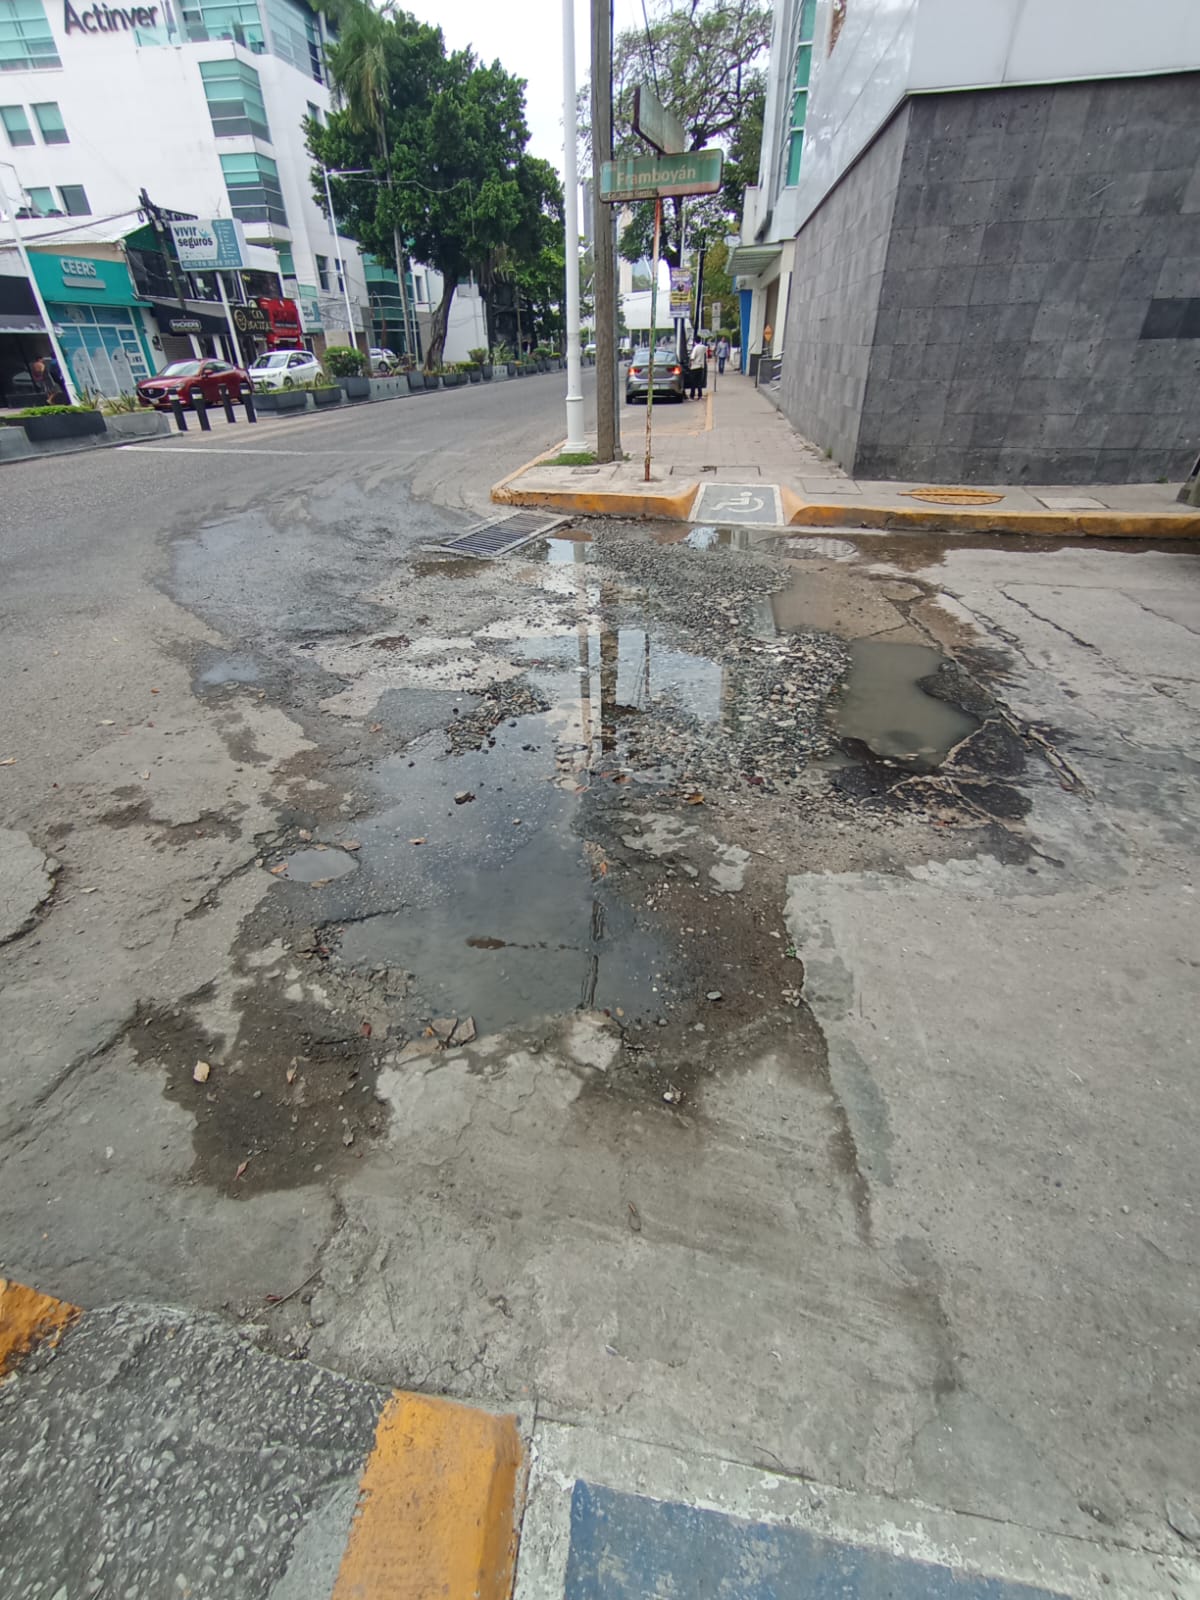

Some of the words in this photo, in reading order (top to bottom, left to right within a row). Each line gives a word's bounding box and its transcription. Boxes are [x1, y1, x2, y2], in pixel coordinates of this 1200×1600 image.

[64, 0, 158, 35] Actinver
[616, 164, 697, 186] Framboyán
[178, 237, 213, 249] seguros
[60, 258, 97, 276] CEERS
